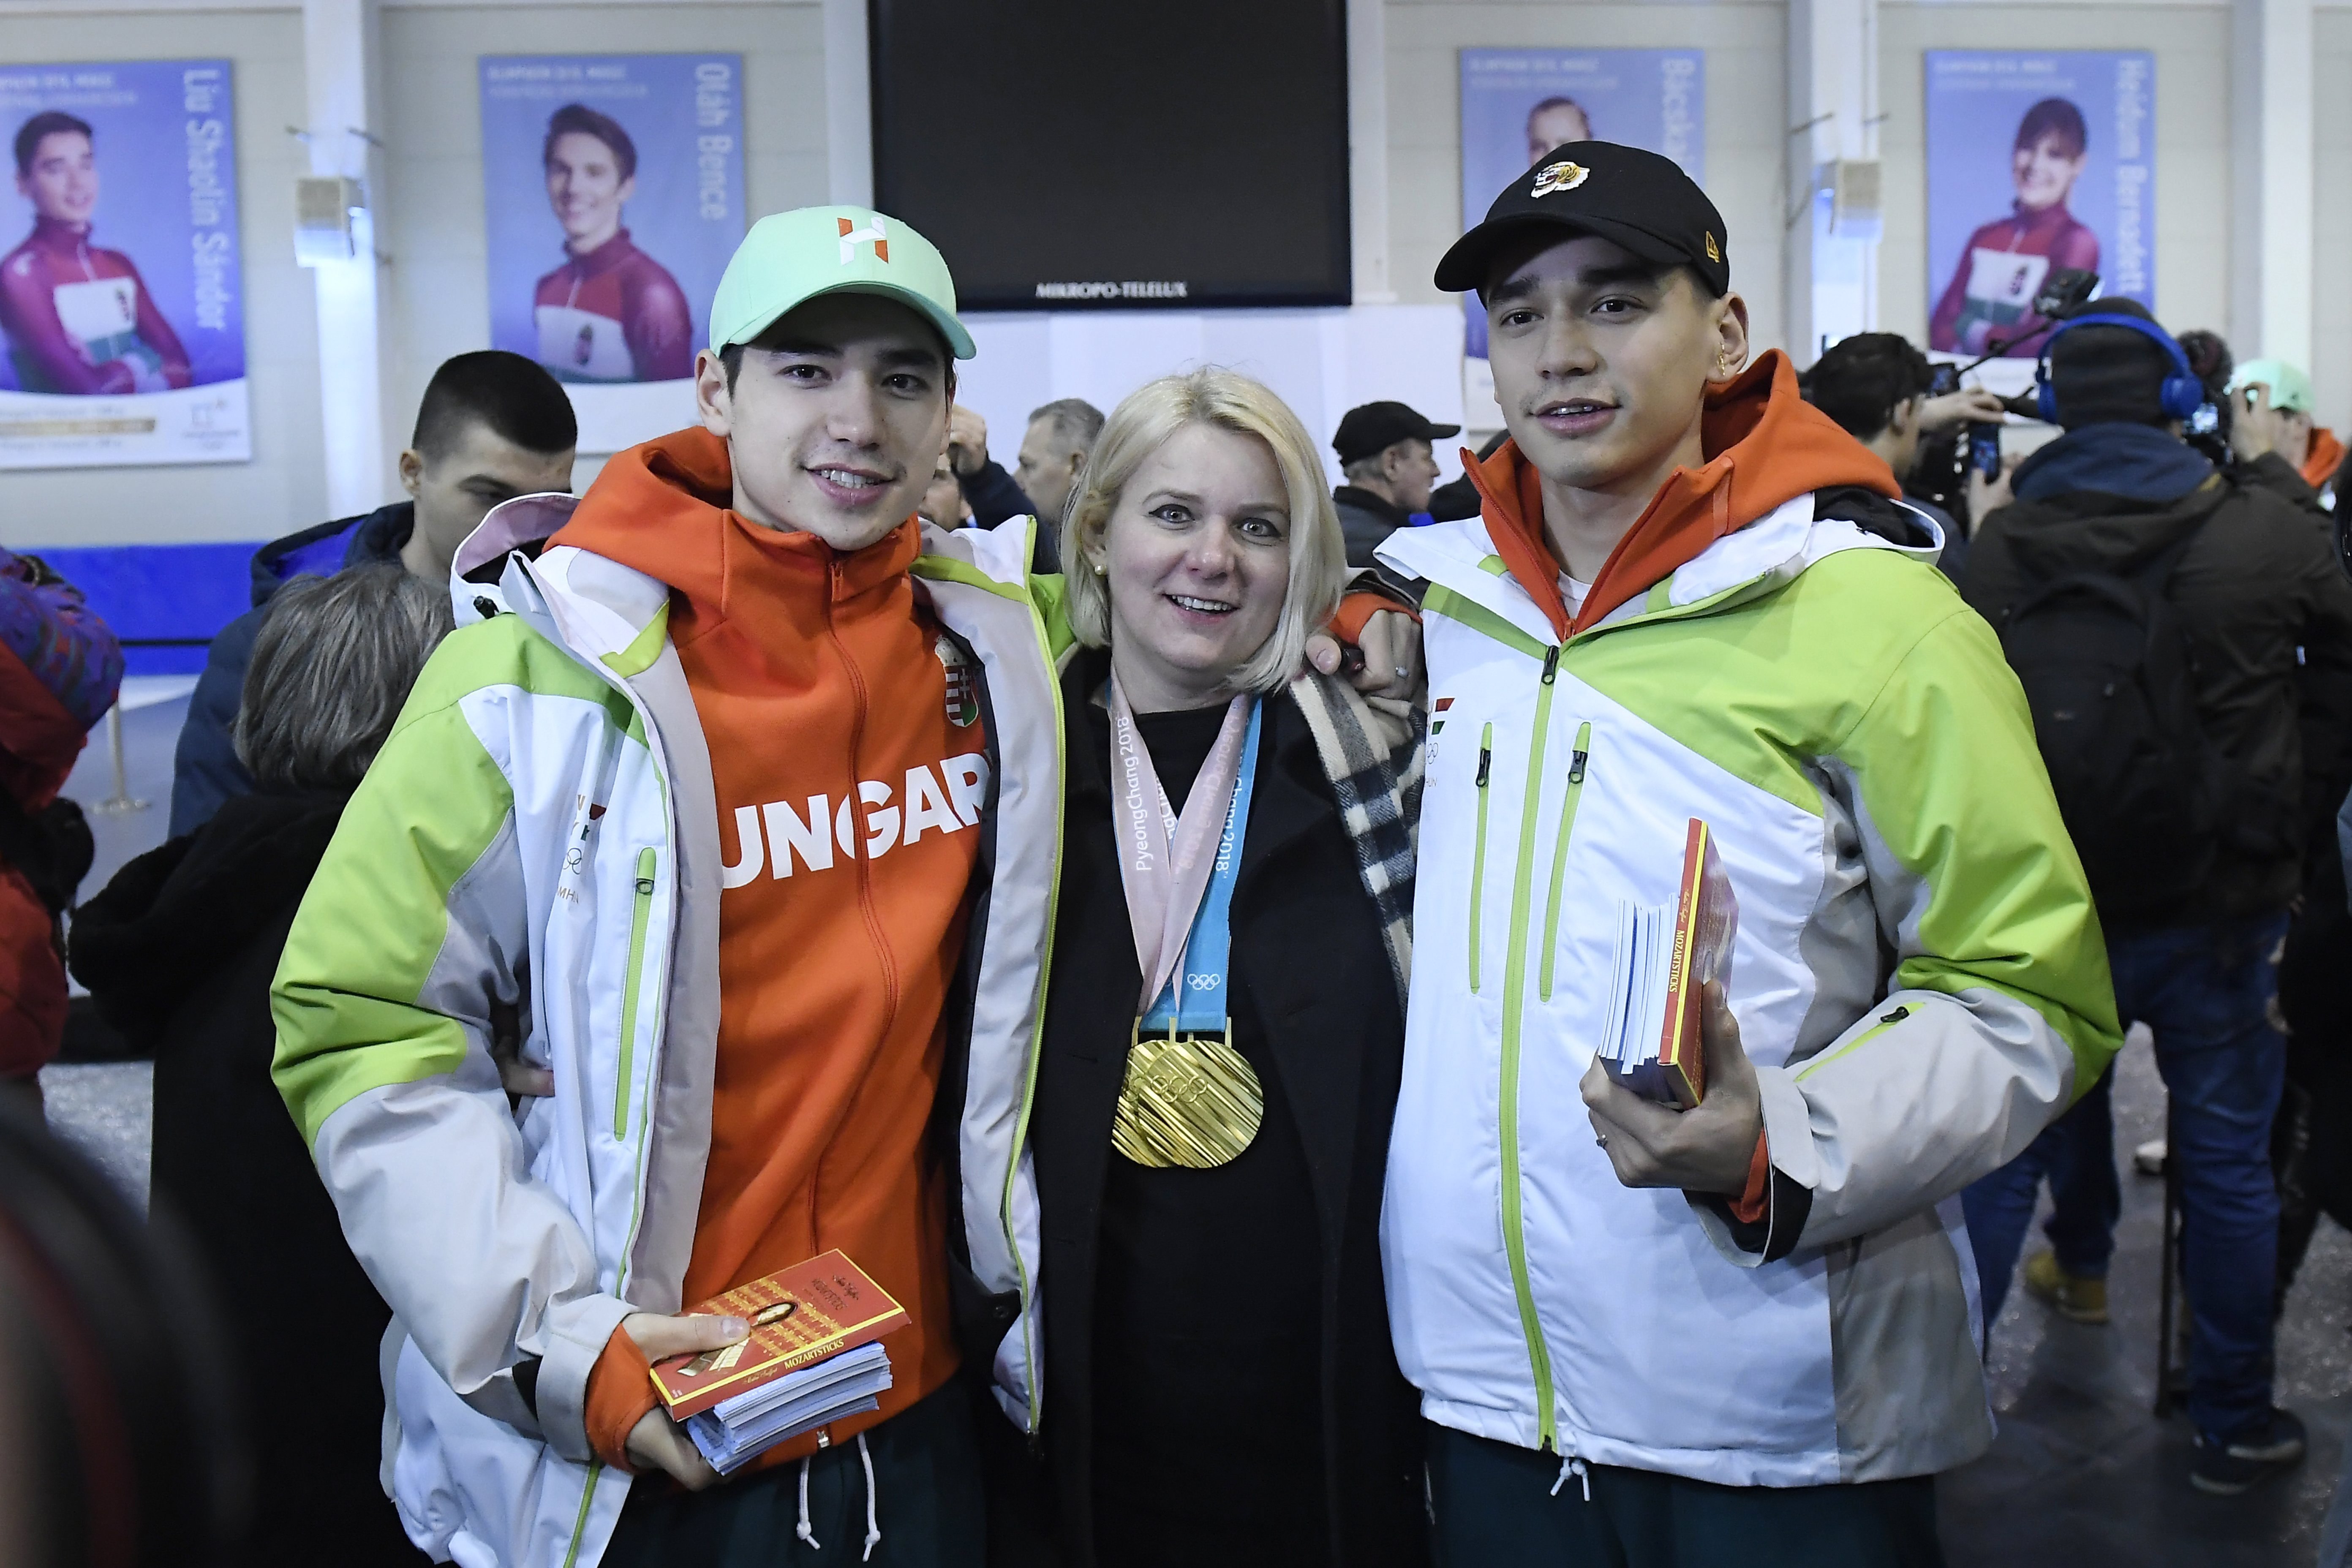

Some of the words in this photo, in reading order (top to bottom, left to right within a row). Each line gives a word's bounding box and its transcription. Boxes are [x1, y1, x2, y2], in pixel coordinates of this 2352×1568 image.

[184, 69, 221, 112] Liu
[185, 119, 228, 226] Shaolin
[697, 135, 733, 221] Bence
[1117, 717, 1133, 755] 2018
[723, 753, 992, 889] UNGAR
[1124, 756, 1154, 871] PyeongChang
[1215, 832, 1235, 871] 2018
[1669, 930, 1685, 993] MOZARTSTICKS
[784, 1339, 844, 1370] MOZARTSTICKS
